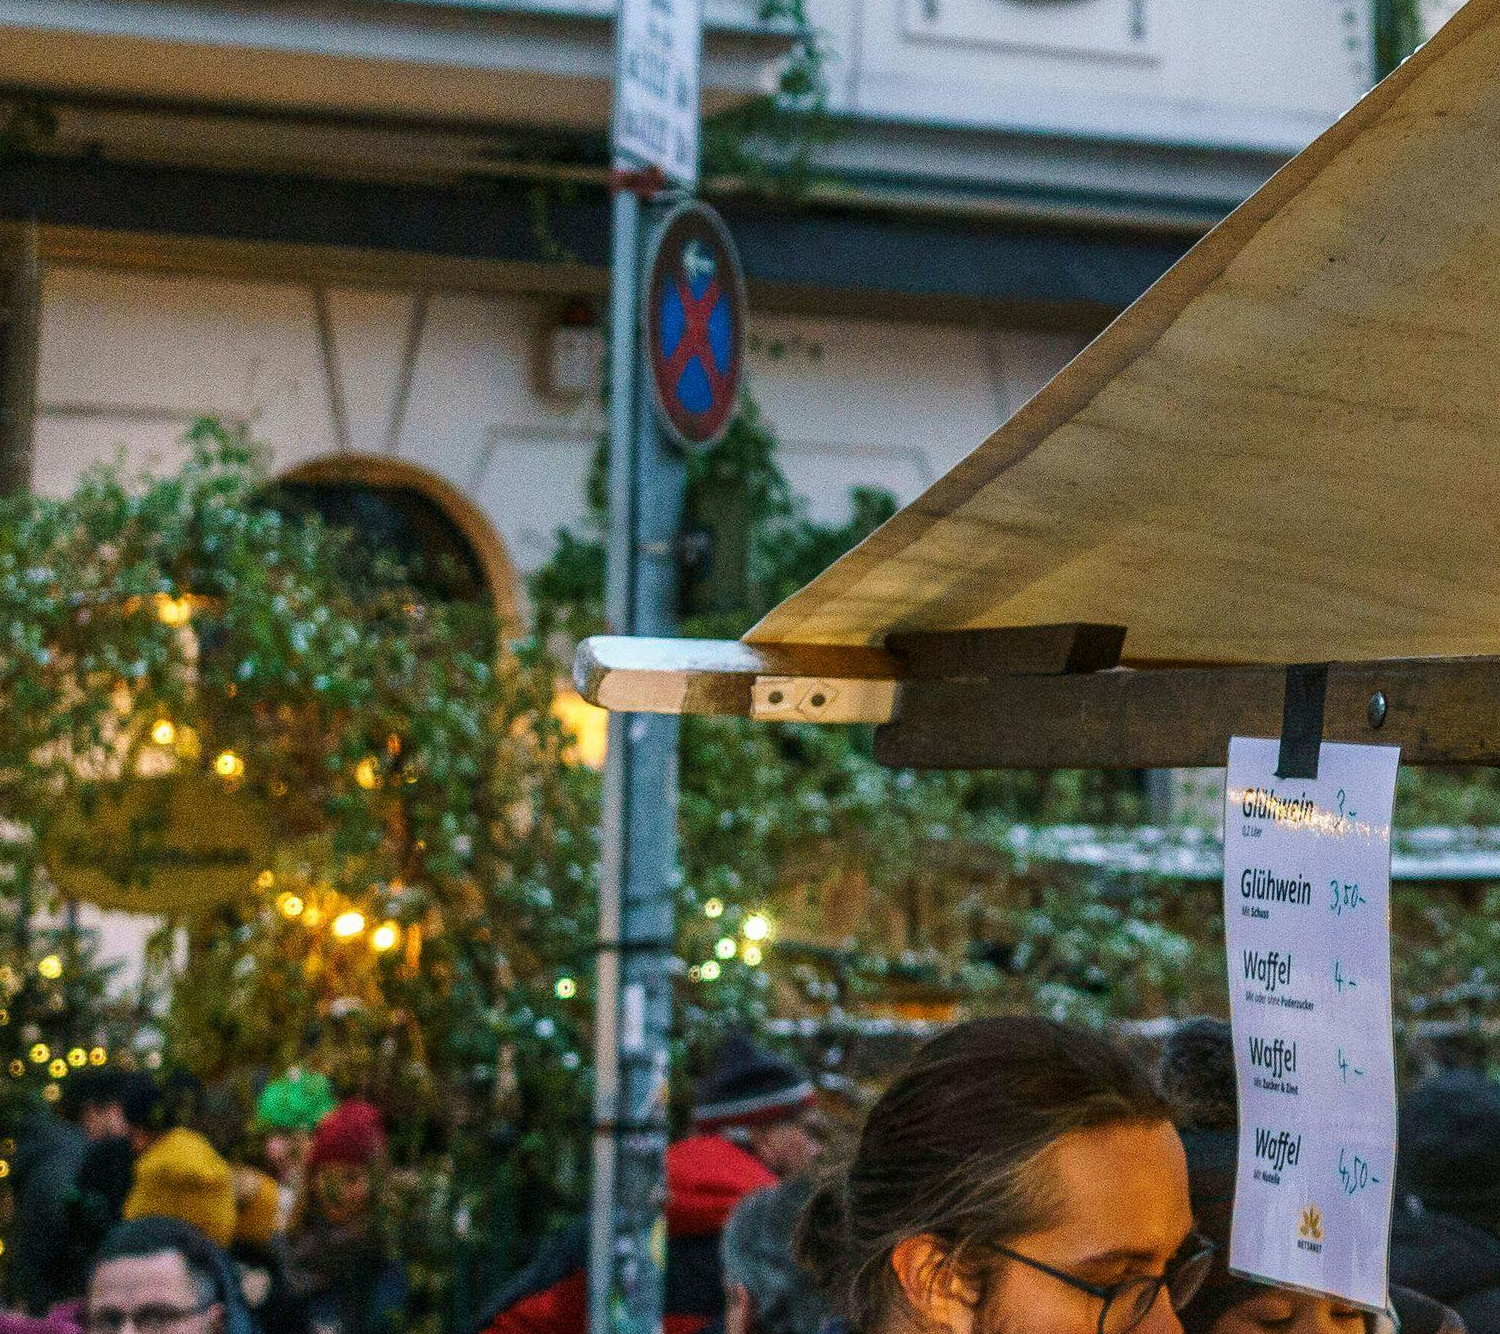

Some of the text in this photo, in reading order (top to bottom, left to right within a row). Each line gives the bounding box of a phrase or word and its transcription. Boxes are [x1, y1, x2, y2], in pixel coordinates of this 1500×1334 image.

[1242, 787, 1314, 822] Glühwein
[1241, 869, 1311, 905] Glühwein
[1243, 950, 1292, 991] Waffel
[1249, 1037, 1297, 1078] Waffel
[1255, 1127, 1301, 1171] Waffel
[1297, 1239, 1322, 1254] NETSANET
